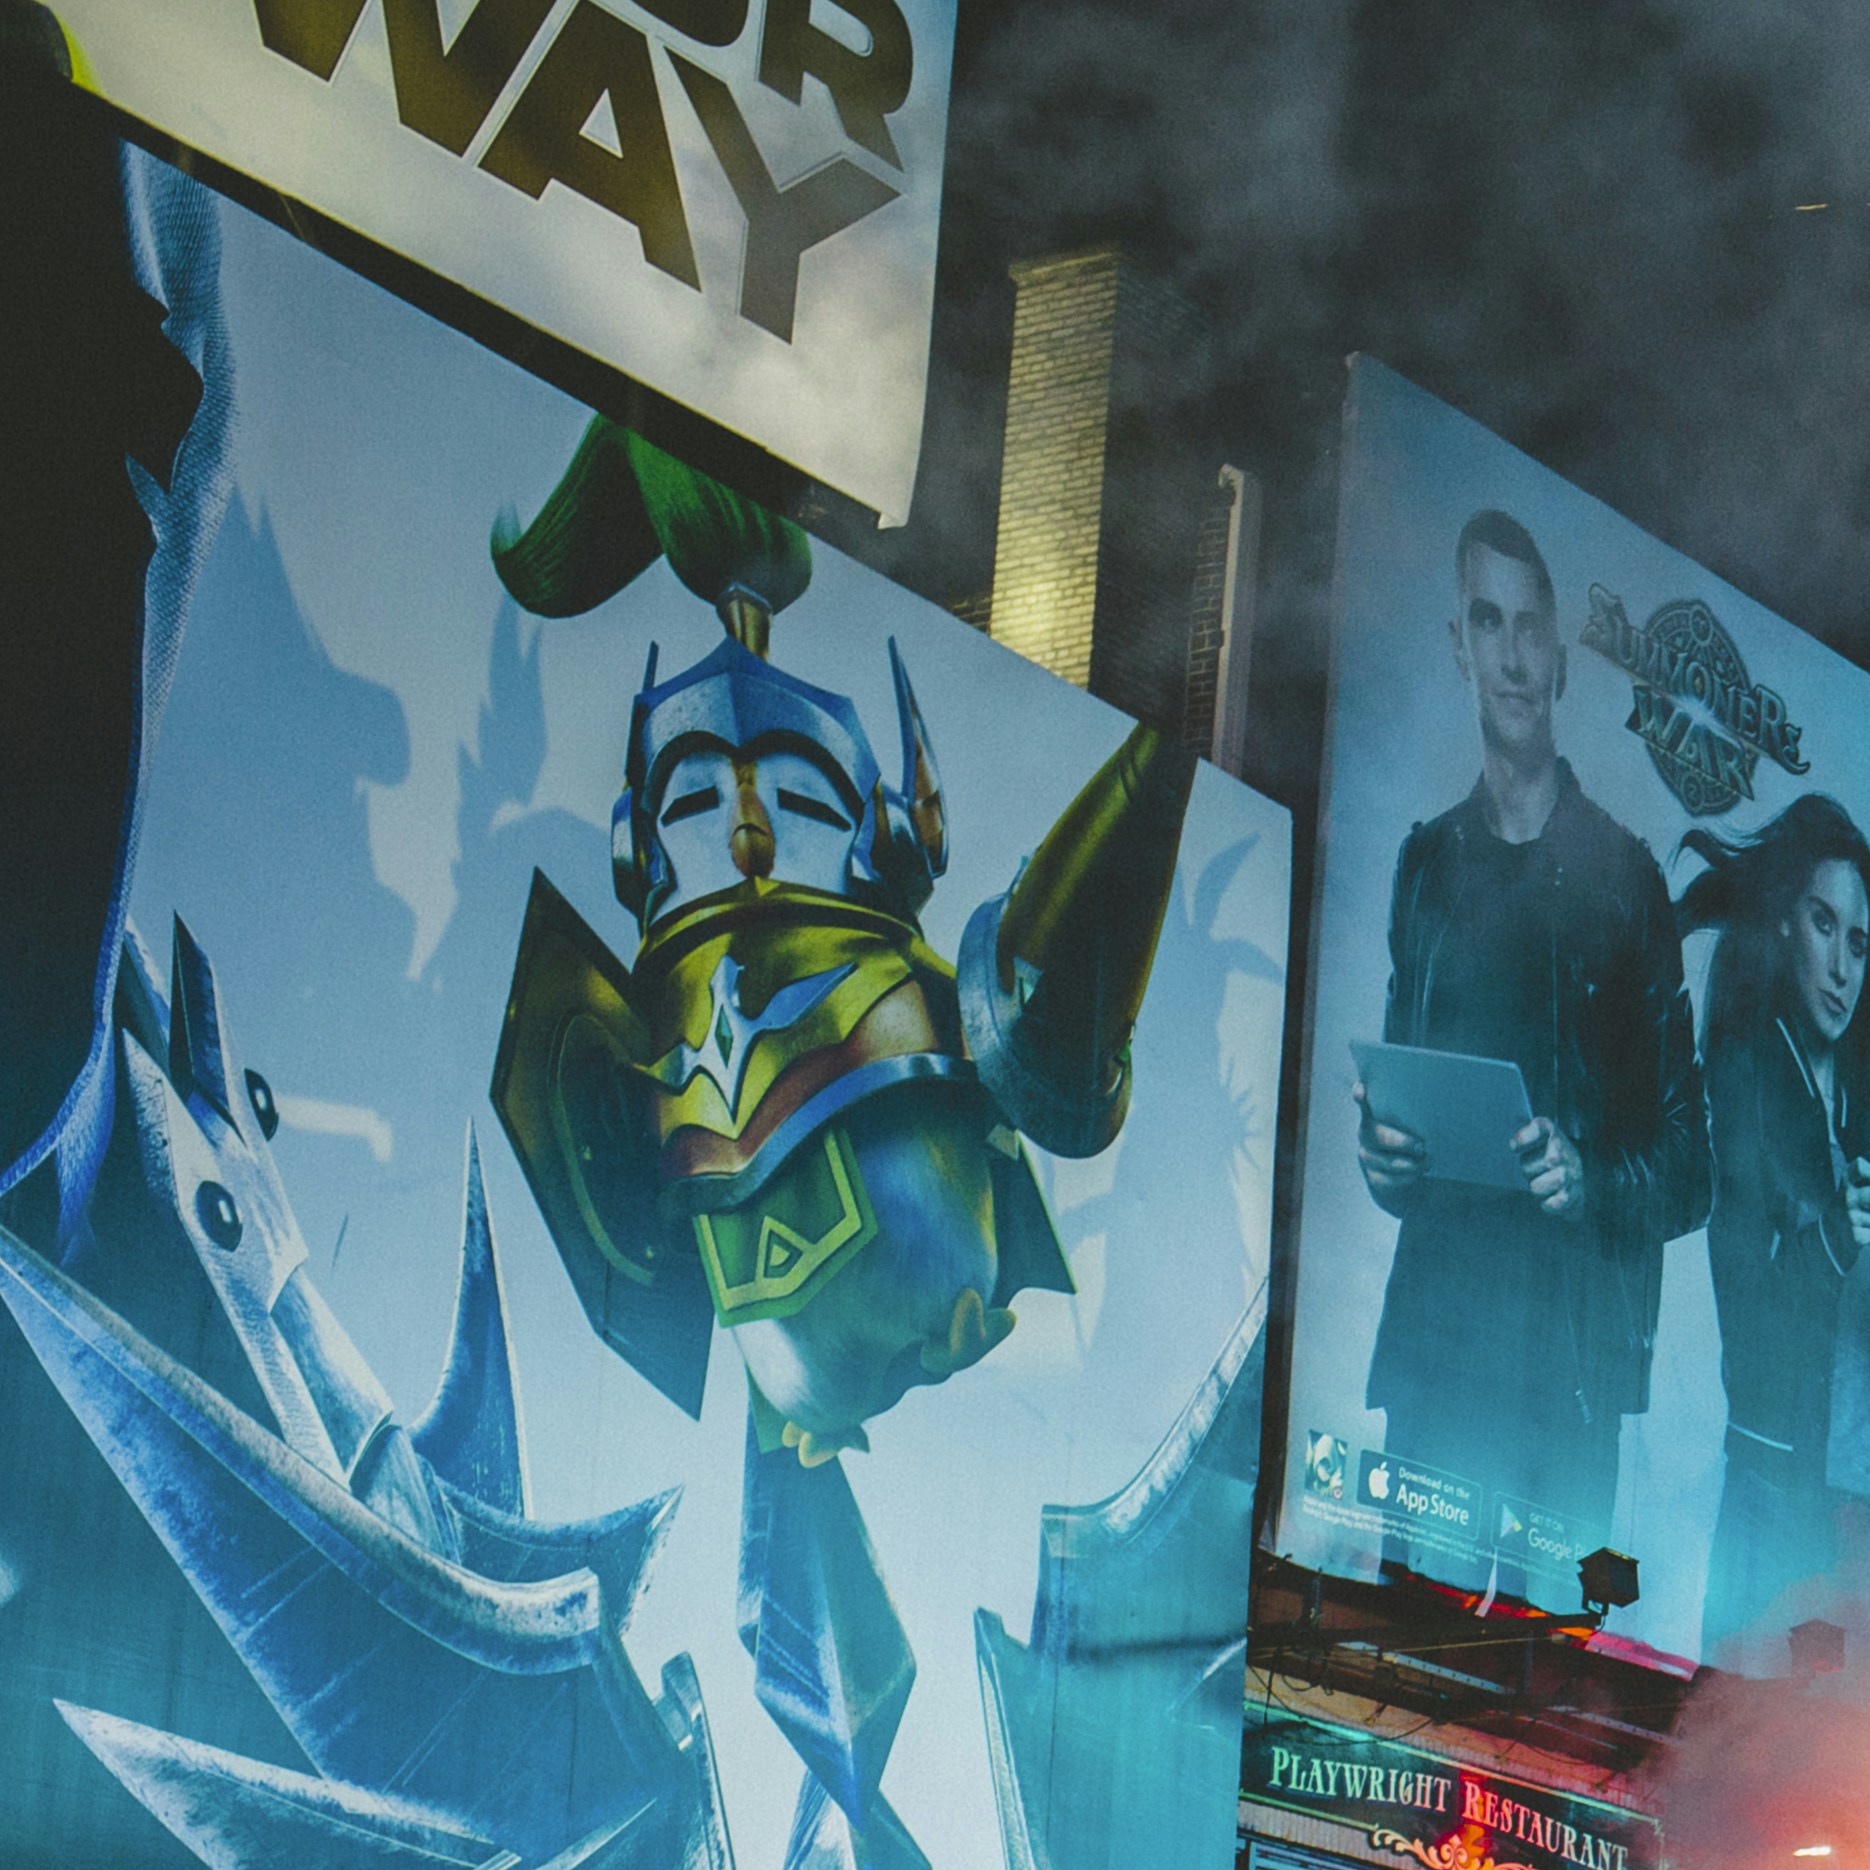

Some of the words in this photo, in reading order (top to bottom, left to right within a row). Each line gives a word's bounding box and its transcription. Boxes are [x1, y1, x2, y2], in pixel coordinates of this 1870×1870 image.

[1630, 685, 1756, 800] WAR
[1396, 1483, 1428, 1514] App
[1430, 1492, 1470, 1526] Store
[1526, 1528, 1573, 1561] Google
[1270, 1746, 1452, 1812] PLAYWRIGHT
